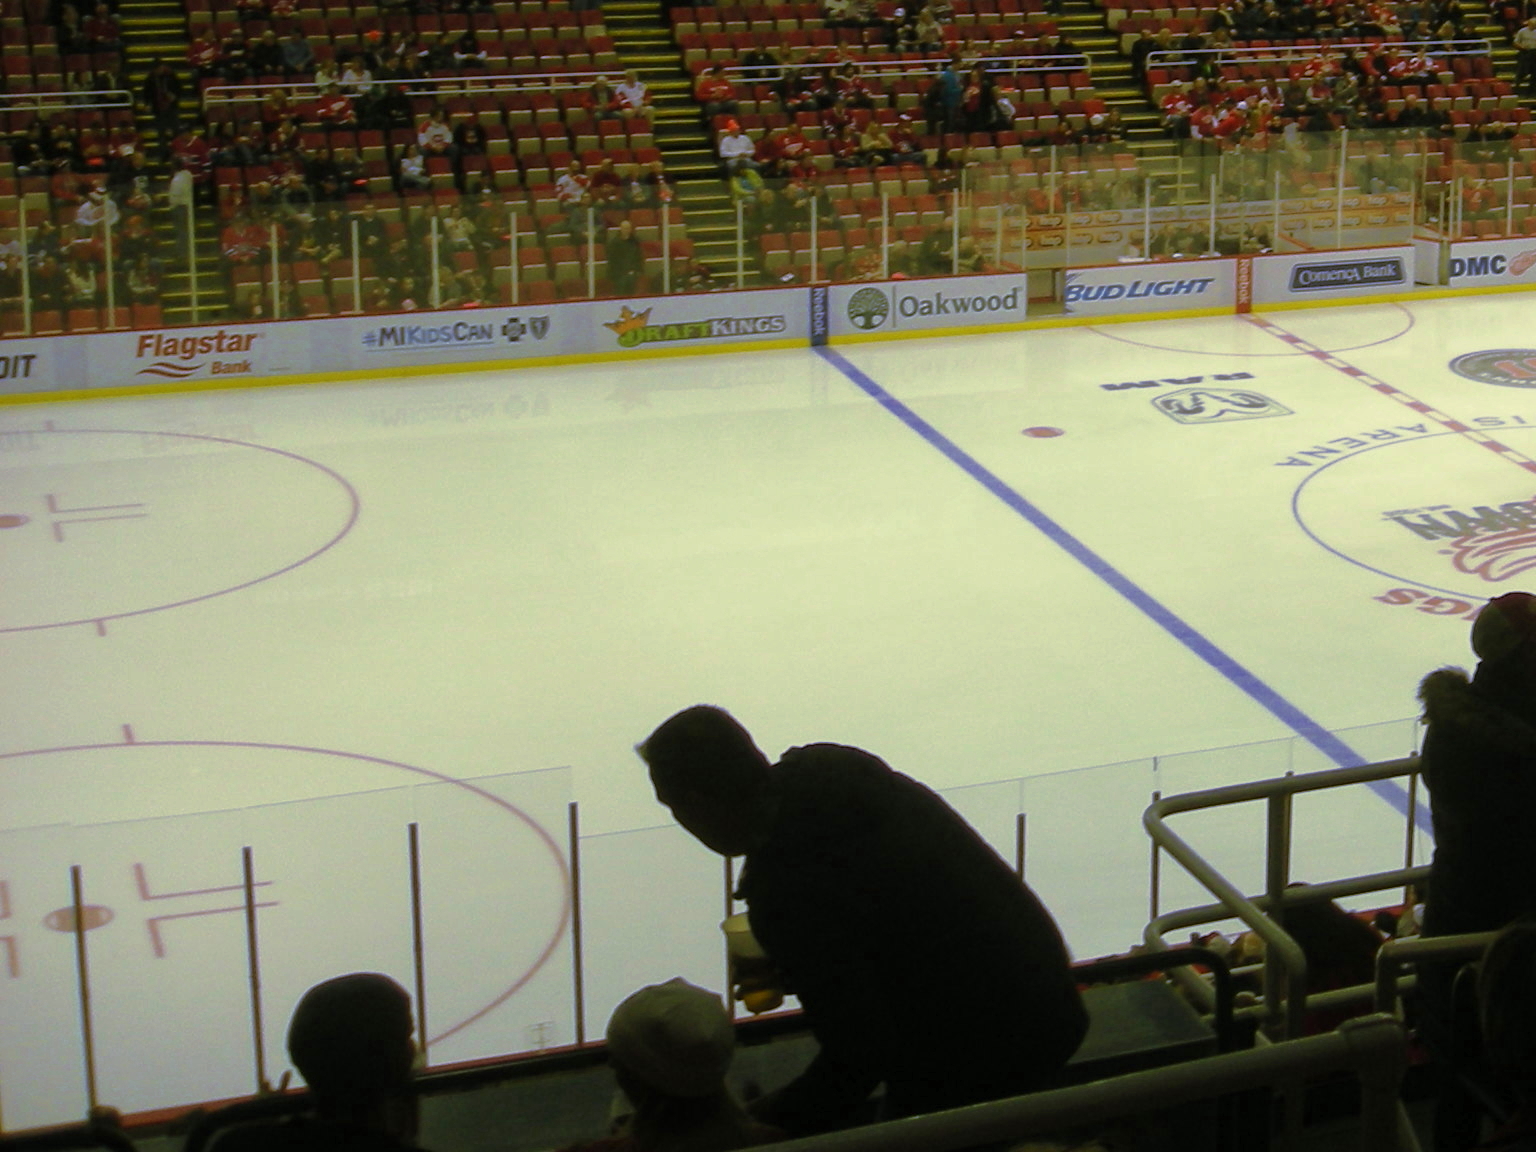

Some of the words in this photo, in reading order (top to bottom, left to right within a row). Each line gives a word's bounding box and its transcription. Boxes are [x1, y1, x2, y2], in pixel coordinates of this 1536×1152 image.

[1299, 266, 1361, 288] Comerica
[1362, 262, 1400, 282] Bank
[1448, 254, 1507, 278] DMC
[899, 286, 1020, 319] Oakwood
[1065, 282, 1127, 304] BUD
[1125, 277, 1216, 300] LIGHT
[134, 333, 259, 360] Flagstar
[210, 360, 253, 375] Bank
[1273, 422, 1431, 468] ARENA
